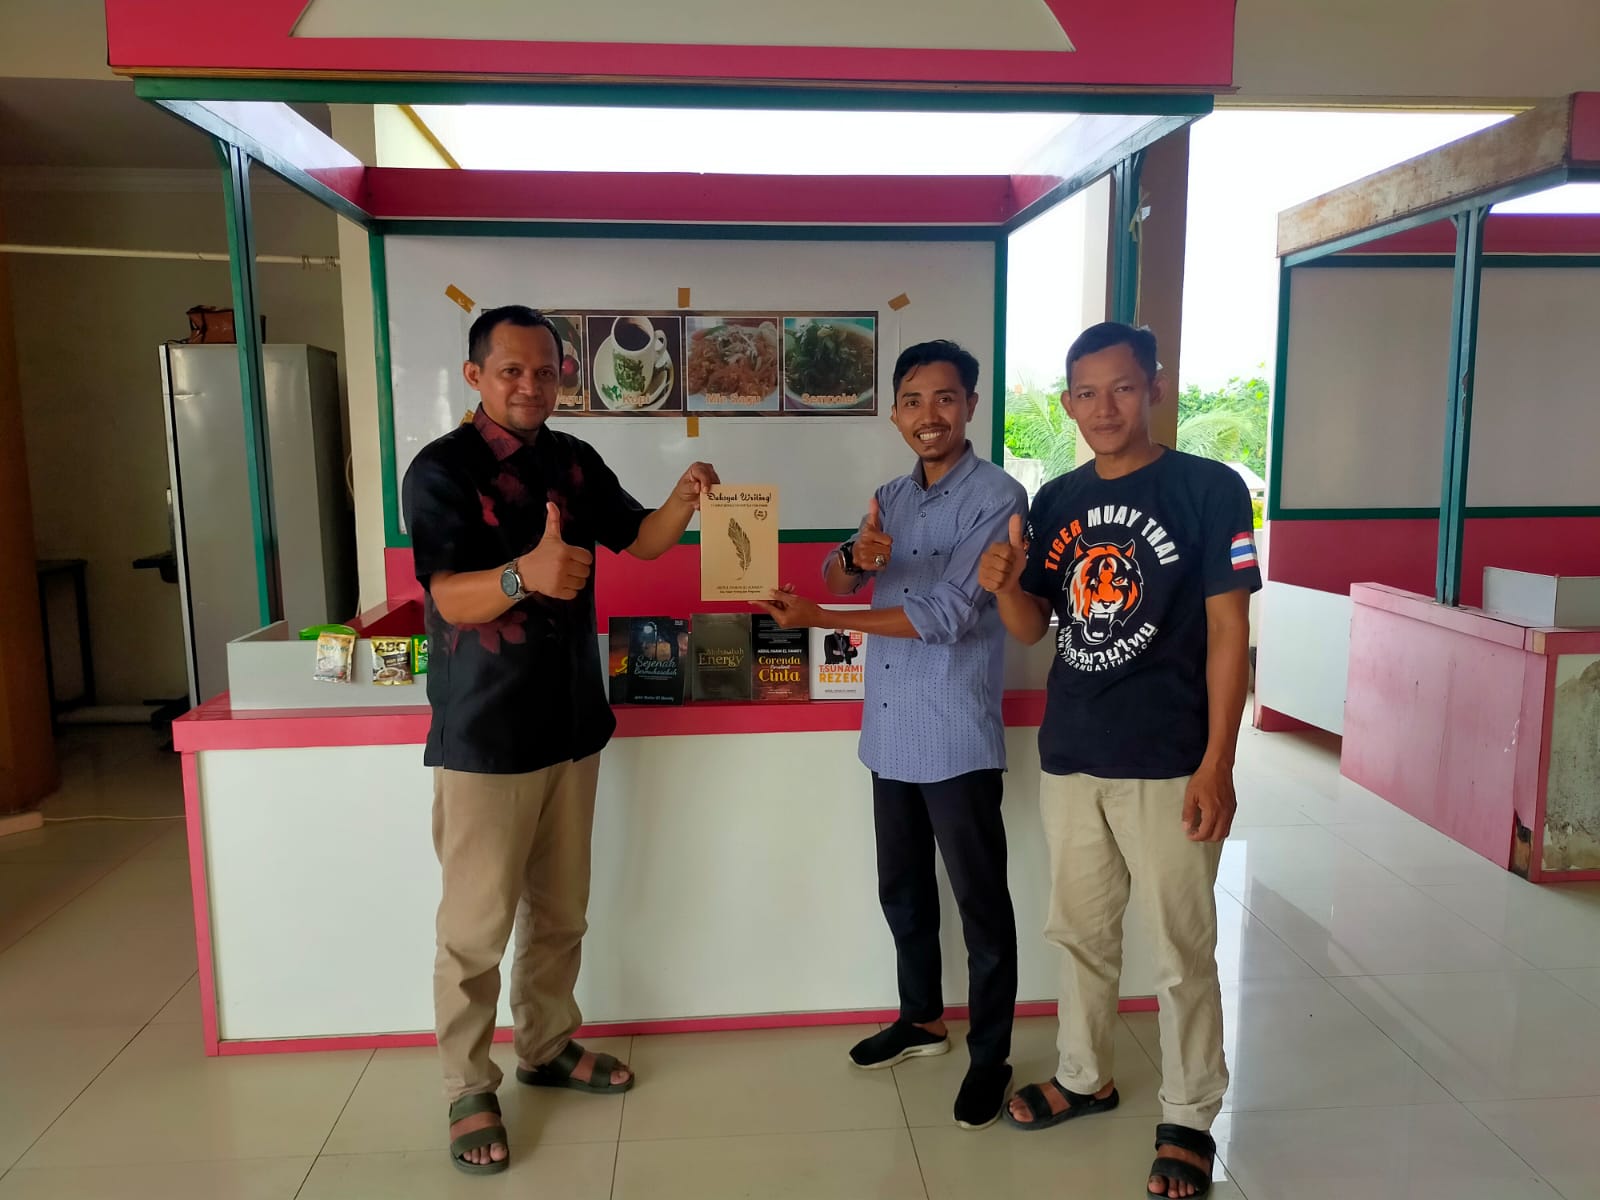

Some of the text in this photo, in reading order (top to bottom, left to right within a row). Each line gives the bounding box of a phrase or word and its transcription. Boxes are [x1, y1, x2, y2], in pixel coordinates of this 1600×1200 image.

[1045, 519, 1083, 571] TIGER
[1087, 504, 1143, 528] MUAY
[1140, 517, 1180, 566] THAI
[375, 642, 407, 653] ABC
[698, 653, 742, 668] Energy
[758, 656, 801, 665] Corenda
[819, 665, 863, 673] TSUNAMI
[758, 668, 801, 682] Cinta
[819, 673, 863, 684] REZEKI
